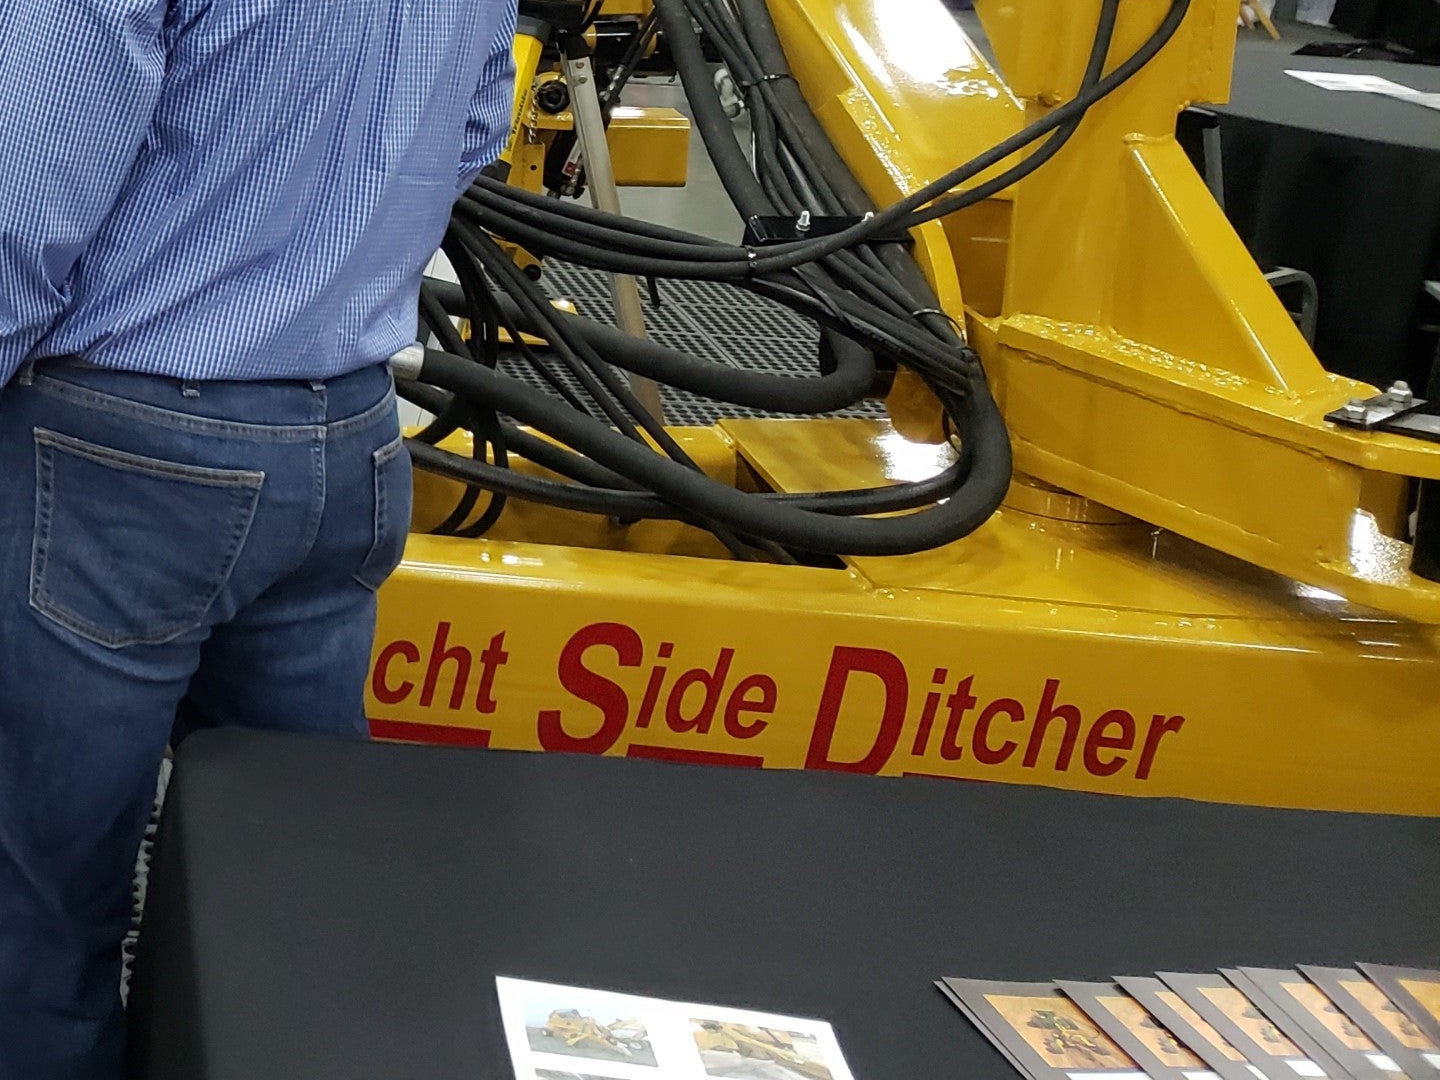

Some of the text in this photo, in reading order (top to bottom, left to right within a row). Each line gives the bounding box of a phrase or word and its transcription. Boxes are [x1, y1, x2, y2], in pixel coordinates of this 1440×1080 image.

[371, 621, 1184, 780] cht Side Ditcher
